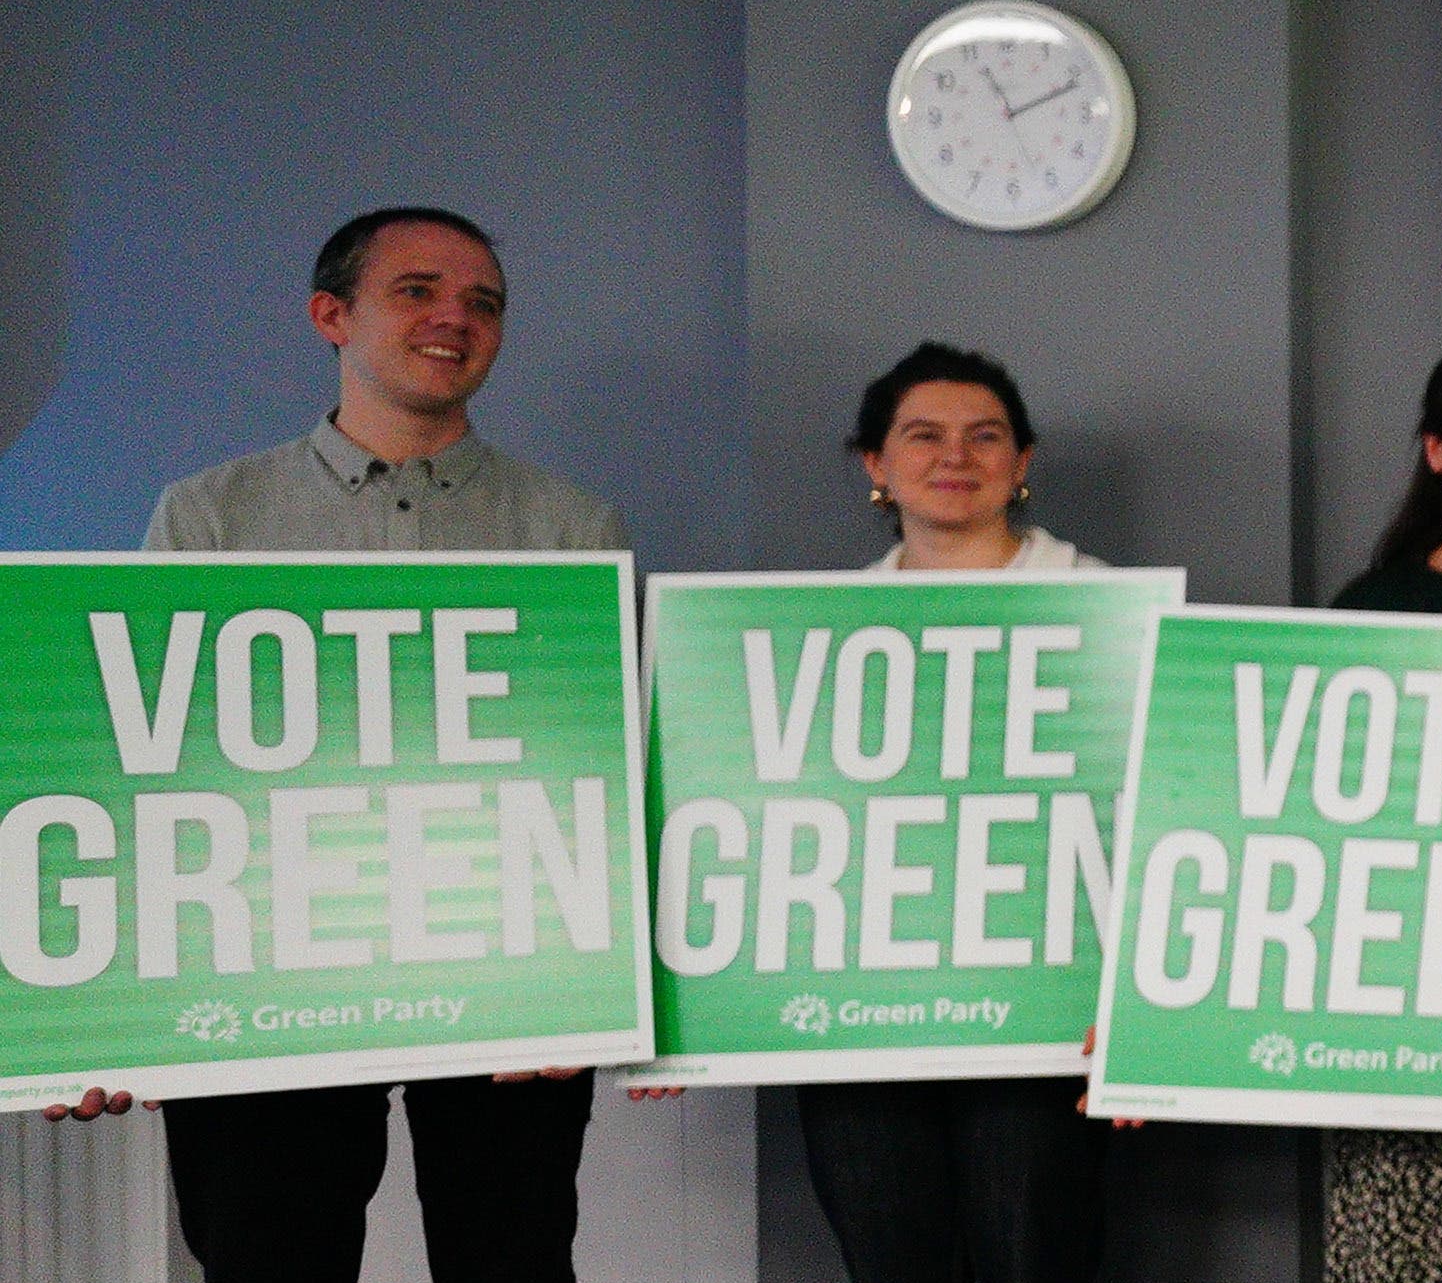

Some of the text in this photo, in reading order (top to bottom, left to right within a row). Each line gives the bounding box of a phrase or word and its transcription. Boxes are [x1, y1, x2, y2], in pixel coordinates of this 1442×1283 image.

[89, 608, 523, 774] VOTE
[742, 624, 1081, 783] VOTE
[0, 777, 613, 987] GREEN
[252, 996, 466, 1032] Green Party
[838, 998, 1010, 1029] Green Party
[1305, 1043, 1388, 1071] Green
